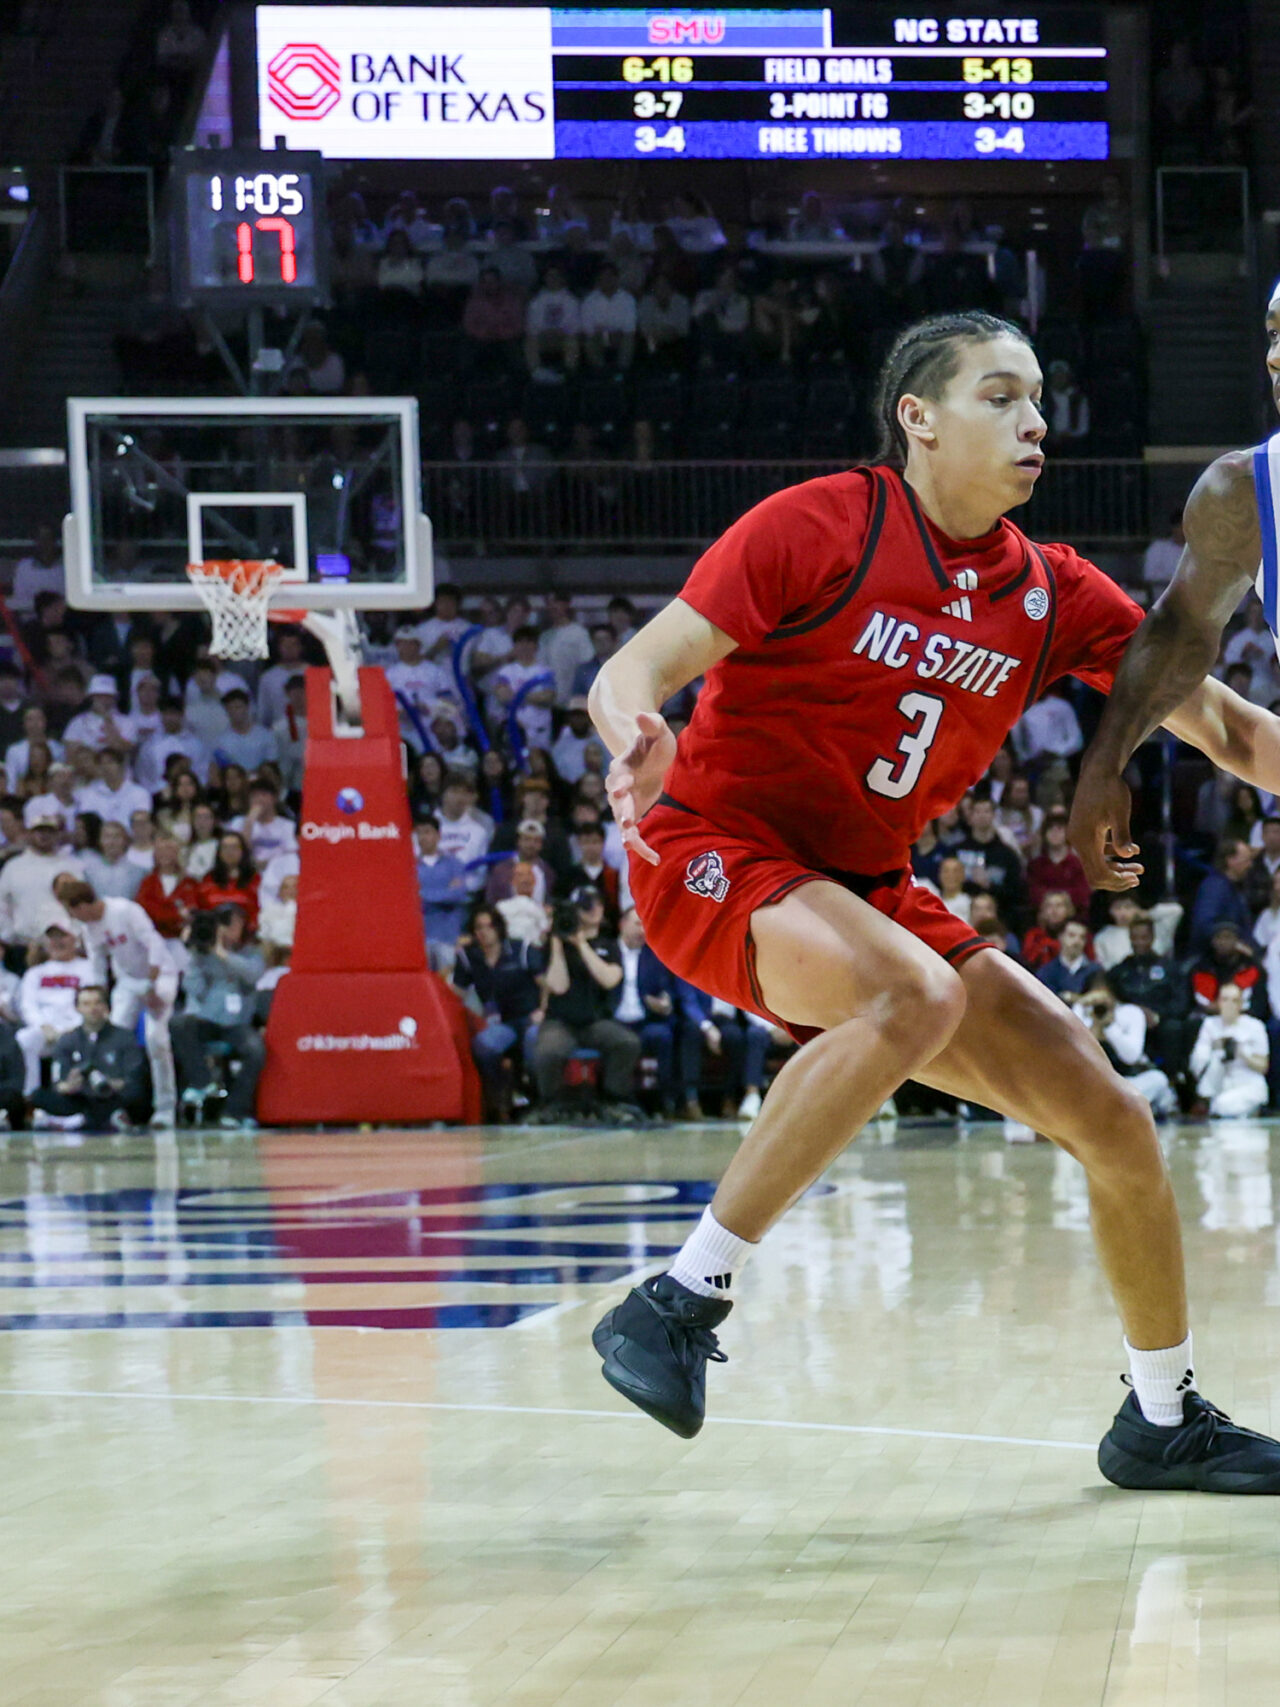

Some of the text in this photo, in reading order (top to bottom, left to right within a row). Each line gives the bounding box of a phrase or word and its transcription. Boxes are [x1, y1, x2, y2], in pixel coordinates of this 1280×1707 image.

[649, 18, 725, 44] SMU
[894, 18, 1039, 43] NC STATE
[351, 53, 465, 84] BANK
[622, 58, 694, 83] 6-16
[764, 58, 893, 84] FIELD GOALS
[962, 58, 1034, 83] 5-13
[352, 92, 546, 122] OF TEXAS
[633, 92, 683, 118] 3-7
[769, 92, 889, 119] 3-POINT FG
[963, 92, 1035, 120] 3-10
[633, 126, 687, 153] 3-4
[758, 127, 902, 153] FREE THROWS
[973, 127, 1026, 153] 3-4
[211, 173, 304, 215] 11:05
[236, 218, 297, 284] 17
[852, 610, 1022, 698] NC STATE
[865, 690, 945, 801] 3
[302, 820, 356, 845] Origin
[358, 820, 400, 840] Bank
